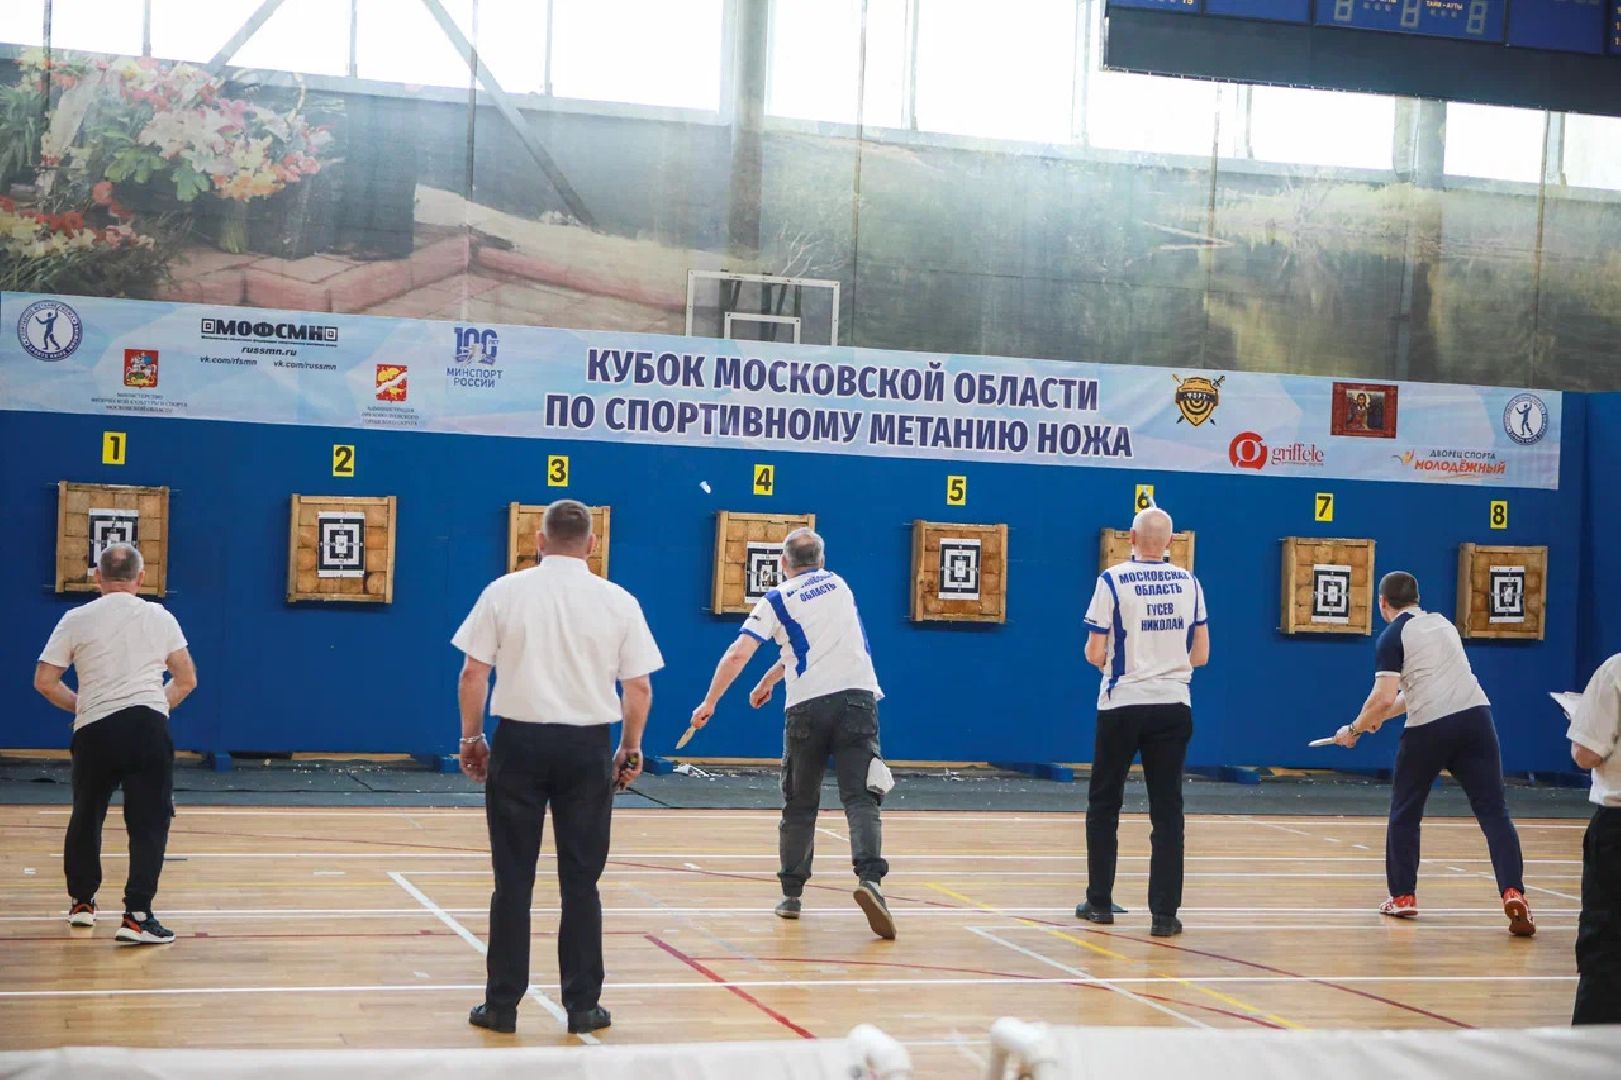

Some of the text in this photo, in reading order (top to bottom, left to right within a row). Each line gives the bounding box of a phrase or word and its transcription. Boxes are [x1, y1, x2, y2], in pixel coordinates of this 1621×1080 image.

[216, 320, 322, 341] МОФСМН
[240, 346, 297, 356] russmn.ru
[454, 326, 498, 365] 100
[273, 359, 337, 370] vk.com/russmn
[446, 367, 503, 379] МИНСПОРТ
[453, 377, 496, 388] РОССИИ
[587, 349, 1098, 411] КУБОК МОСКОВСКОЙ ОБЛАСТИ
[546, 395, 1133, 458] ПО СПОРТИВНОМУ МЕТАНИЮ НОЖА
[110, 435, 120, 460] 1
[1271, 443, 1324, 465] griffele
[1429, 449, 1496, 460] ДВОРЕЦ СПОРТА
[334, 447, 353, 472] 2
[550, 458, 566, 482] 3
[1414, 458, 1506, 474] МОЛОДЁЖНЫЙ
[756, 467, 772, 491] 4
[949, 478, 963, 501] 5
[1317, 495, 1331, 517] 7
[1492, 504, 1505, 525] 8
[1134, 583, 1183, 596] ОБЛАСТЬ
[1146, 602, 1174, 616] ГУСЕВ
[1141, 616, 1185, 631] НИКОЛАЙ
